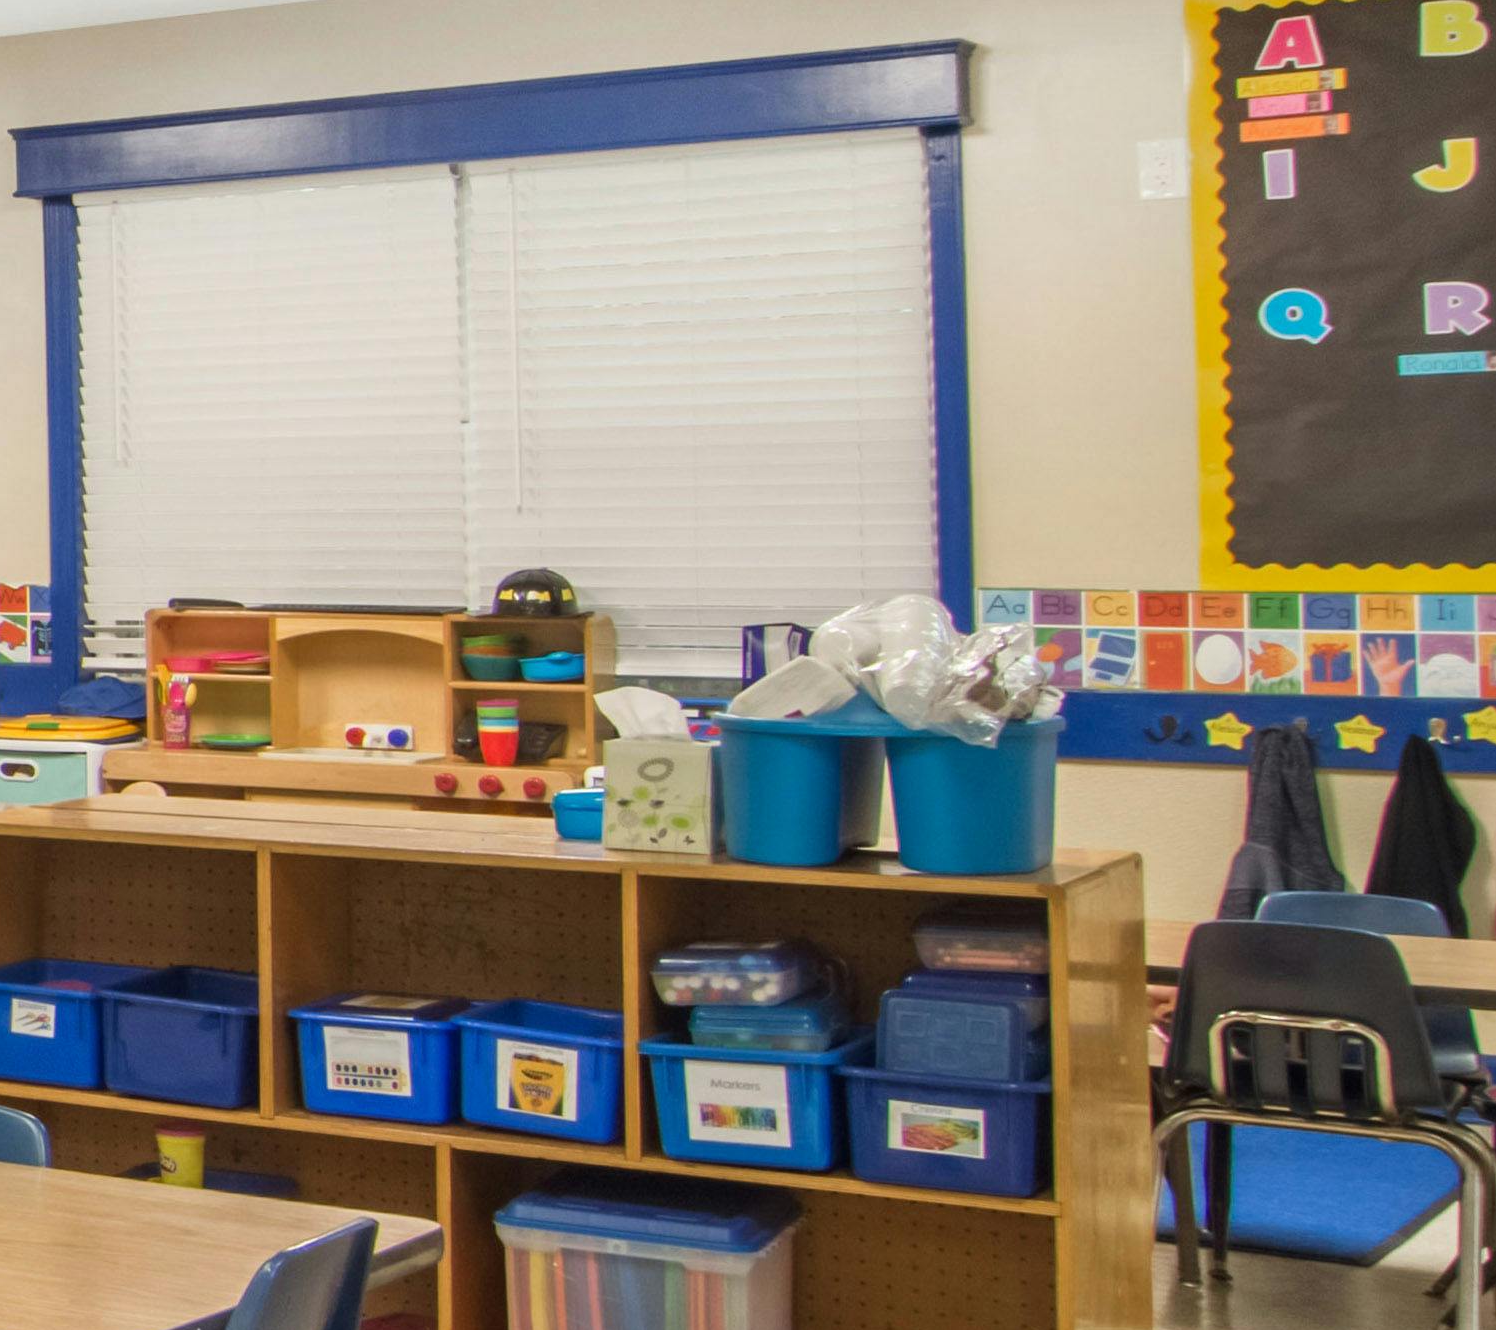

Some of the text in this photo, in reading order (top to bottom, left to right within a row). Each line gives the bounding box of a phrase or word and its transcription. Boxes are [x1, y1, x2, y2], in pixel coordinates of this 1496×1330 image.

[1254, 14, 1325, 70] A
[1262, 147, 1297, 201] I
[1411, 137, 1479, 194] J
[1258, 287, 1334, 345] Q
[1422, 280, 1492, 336] R
[1405, 353, 1481, 372] Ronald
[986, 593, 1026, 616] Aa
[1040, 595, 1078, 617] Bb
[1092, 594, 1129, 617] Cc
[1144, 596, 1183, 619] Dd
[1200, 596, 1238, 619] Ee
[1254, 597, 1289, 619] Ff
[1307, 597, 1351, 628] Gg
[1366, 598, 1408, 621] Hh
[1437, 599, 1457, 621] Ii
[709, 1077, 761, 1092] Markers
